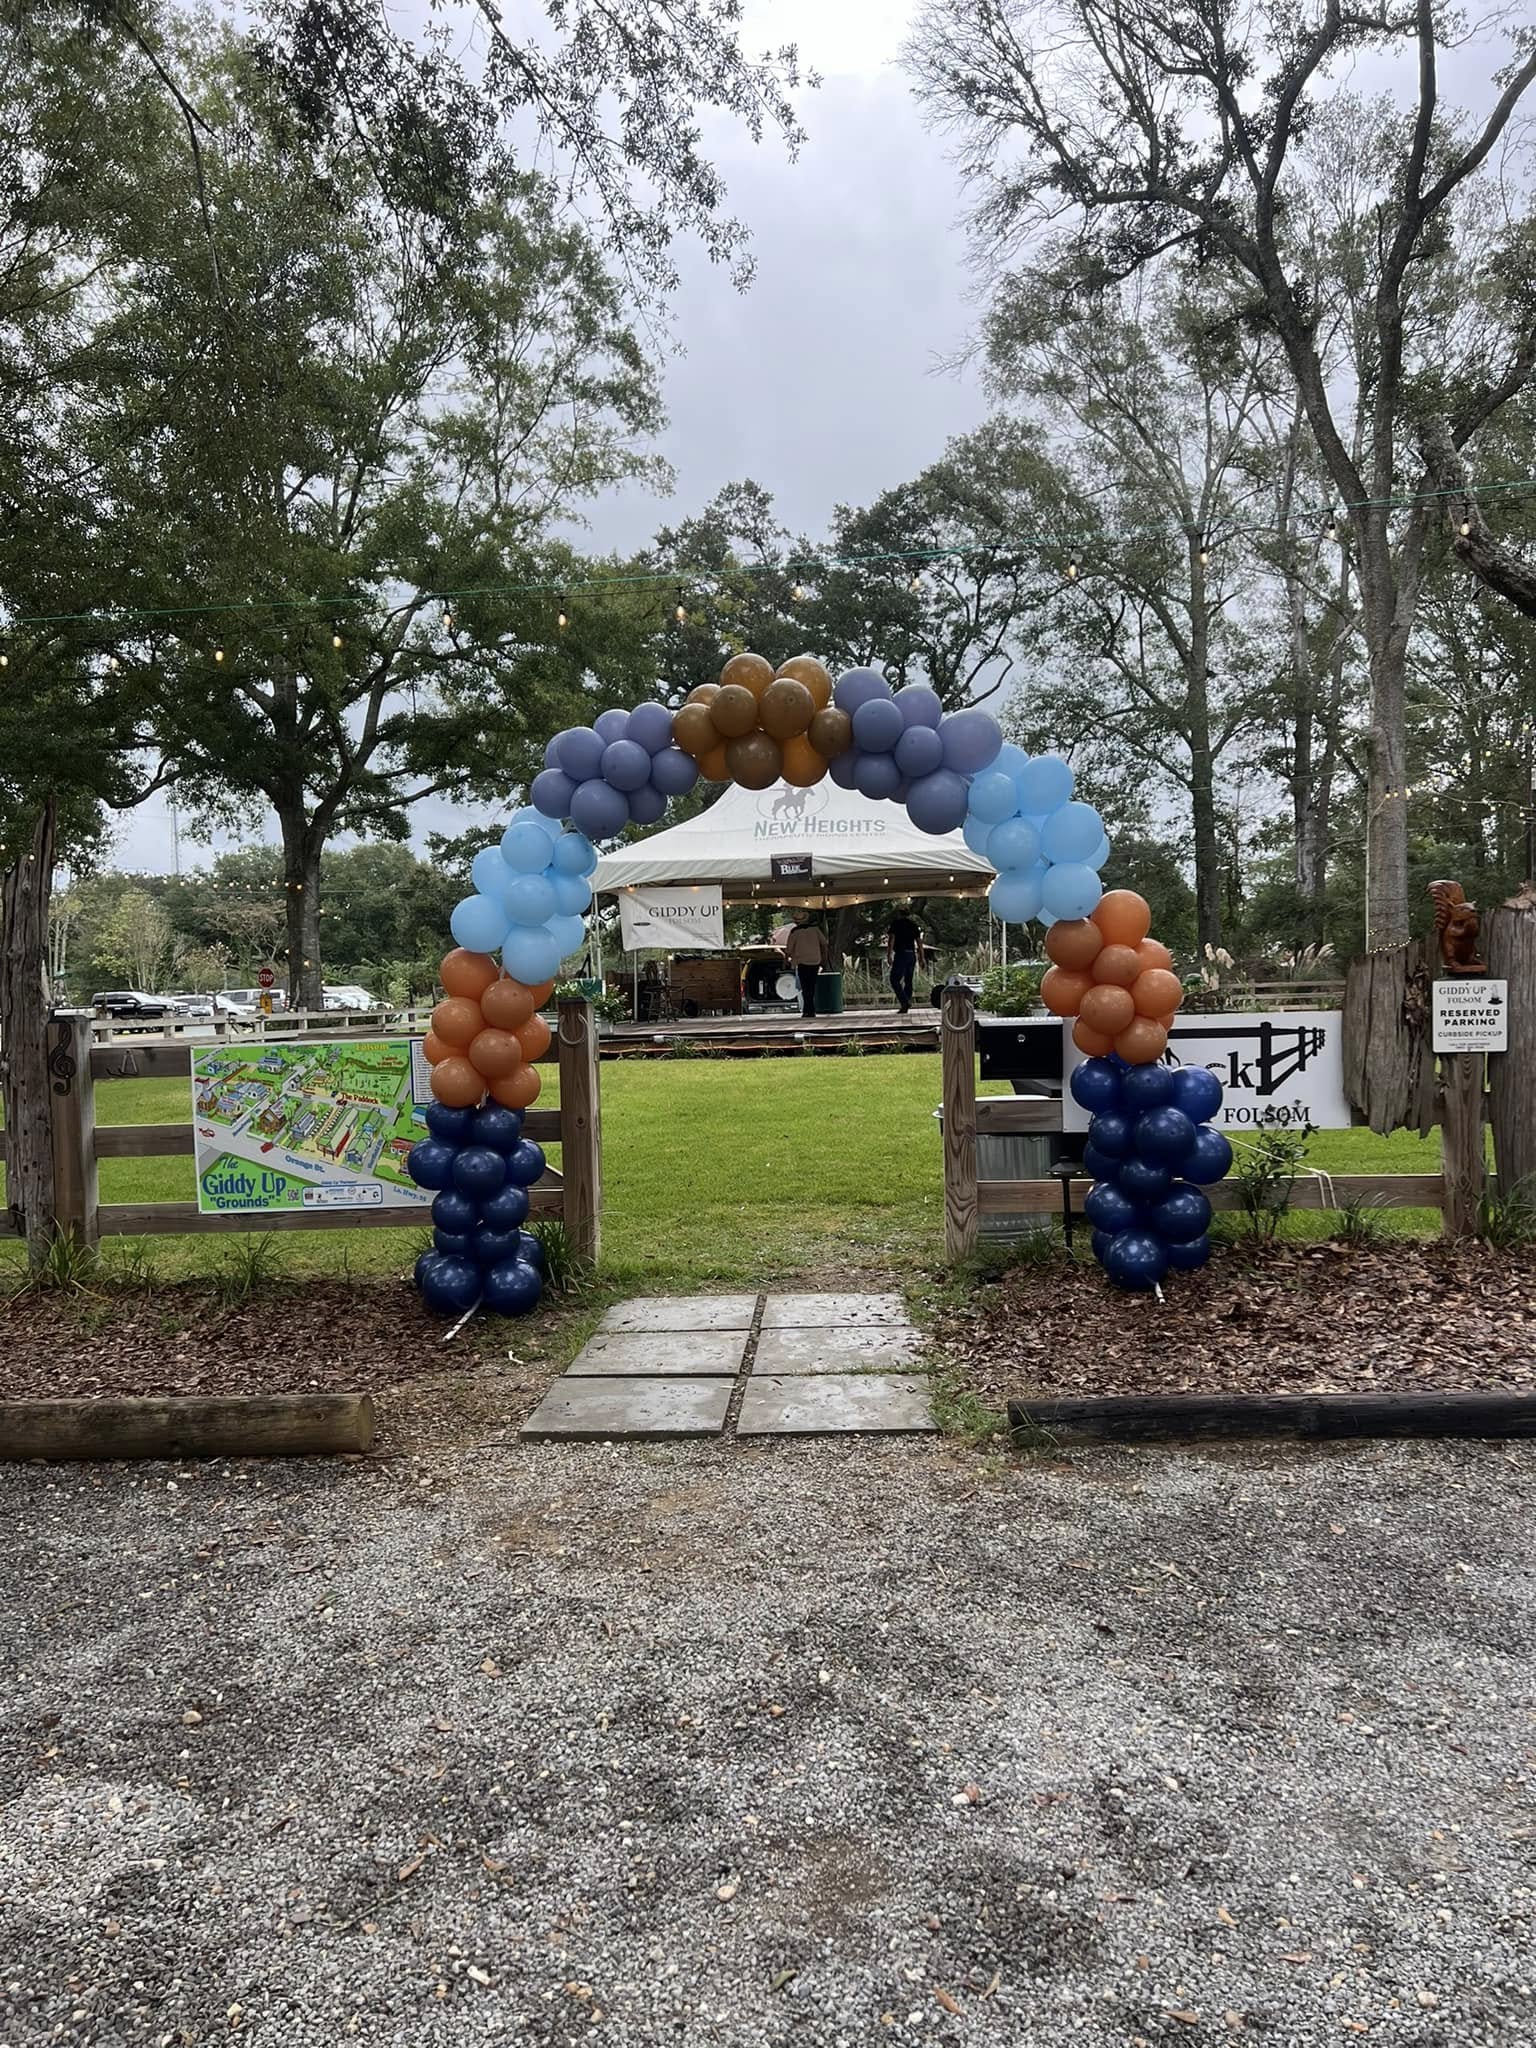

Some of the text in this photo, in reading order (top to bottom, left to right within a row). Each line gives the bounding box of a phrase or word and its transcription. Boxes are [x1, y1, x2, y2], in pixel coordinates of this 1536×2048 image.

[754, 819, 797, 837] NEW
[804, 815, 886, 833] HEIGHTS
[648, 905, 719, 917] GIDDY UP
[260, 973, 274, 982] STOP
[1439, 986, 1487, 995] GIDDY UP
[1447, 996, 1482, 1004] FOLSOM
[1440, 1009, 1500, 1017] RESERVED
[1444, 1018, 1496, 1026] PARKING
[1223, 1106, 1311, 1123] FOLSOM
[221, 1156, 239, 1169] The
[202, 1173, 256, 1198] Giddy
[261, 1172, 286, 1196] Up
[210, 1195, 275, 1209] "Grounds"
